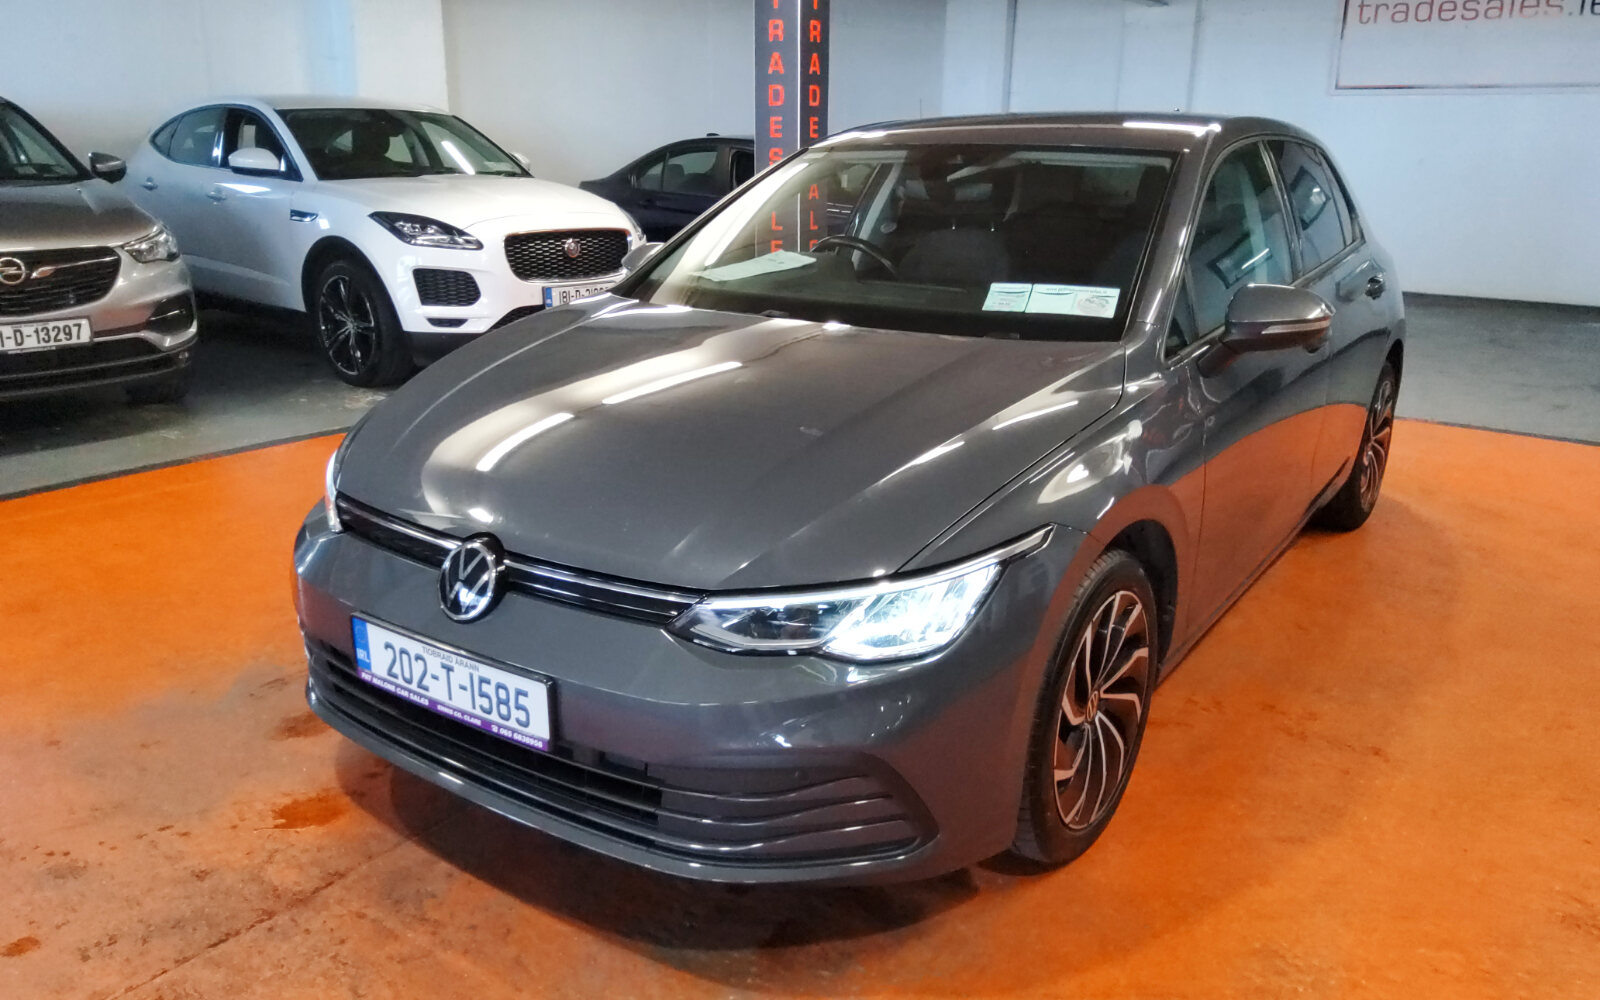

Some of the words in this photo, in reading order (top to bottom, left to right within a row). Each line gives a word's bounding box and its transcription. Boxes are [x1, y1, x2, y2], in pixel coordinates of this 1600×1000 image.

[443, 543, 492, 616] VW
[356, 647, 370, 663] IRL
[384, 641, 531, 728] 202-T-1585
[396, 687, 409, 698] CAR
[409, 693, 429, 706] SALES
[463, 715, 482, 726] CLARE
